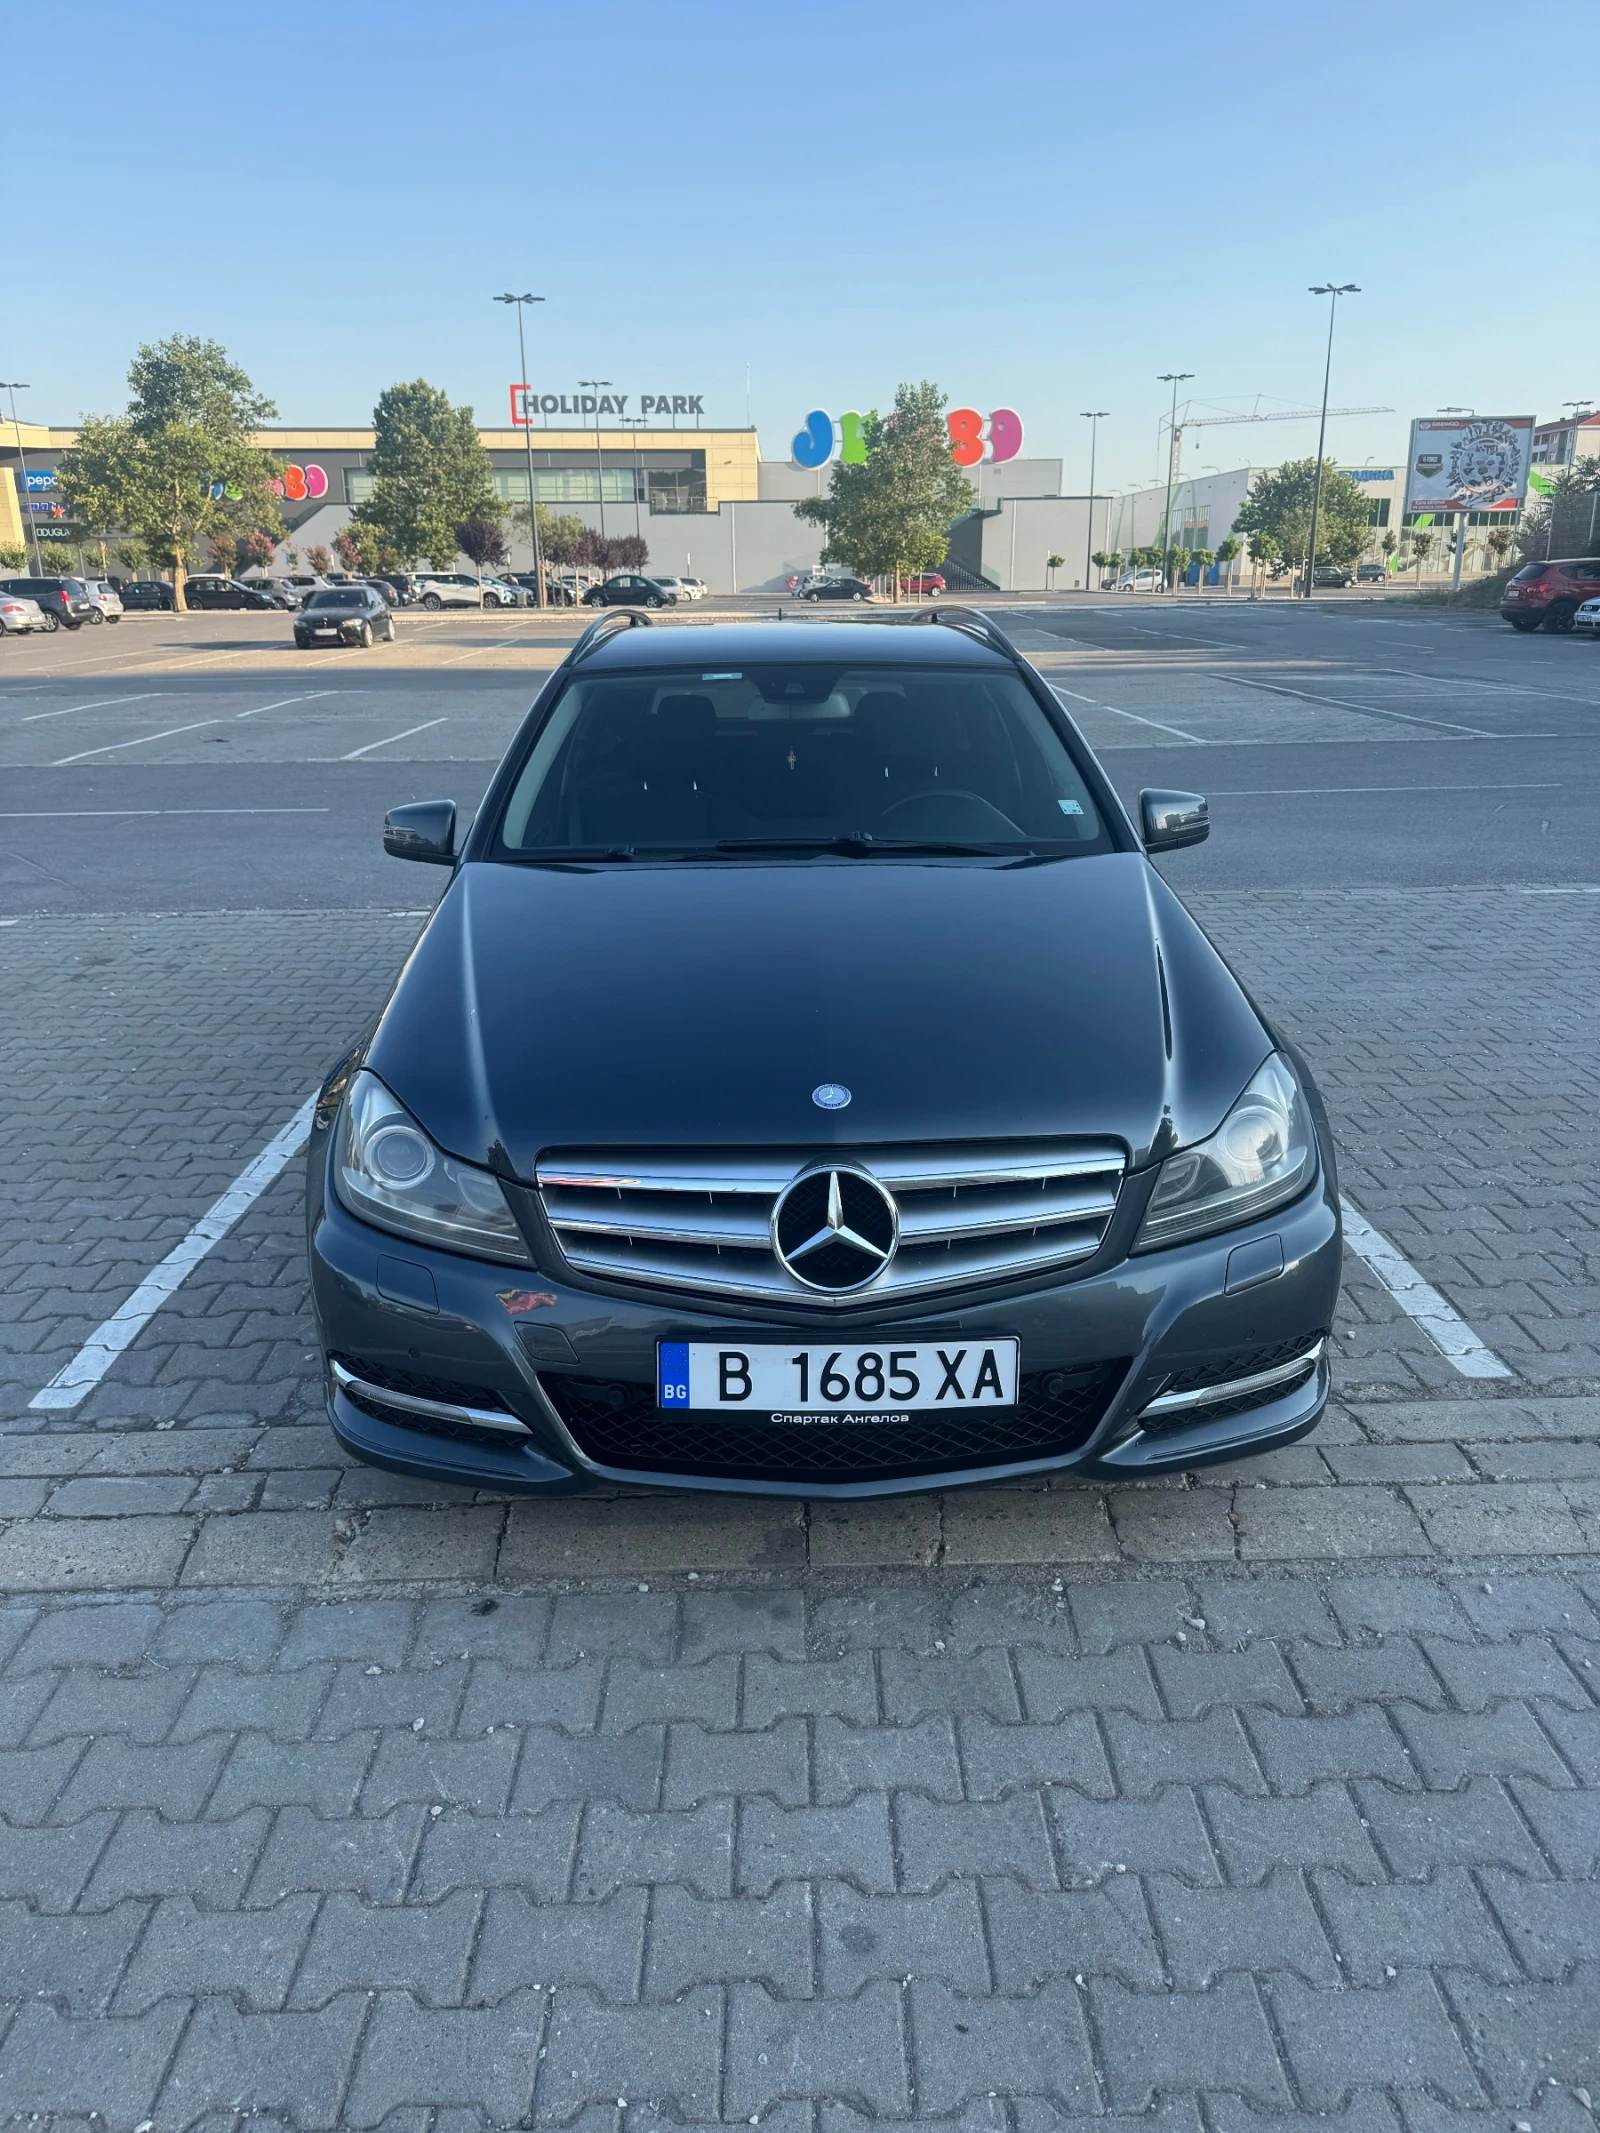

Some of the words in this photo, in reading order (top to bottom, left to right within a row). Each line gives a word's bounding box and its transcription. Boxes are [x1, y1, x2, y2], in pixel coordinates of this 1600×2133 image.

[523, 395, 629, 414] HOLIDAY
[641, 395, 705, 414] PARK
[792, 408, 1024, 471] JUBO
[27, 476, 58, 487] pepc
[719, 1351, 753, 1402] B
[792, 1351, 921, 1402] 1685
[936, 1349, 1004, 1400] XA
[664, 1385, 687, 1399] BG
[770, 1413, 838, 1425] Спартак
[842, 1414, 910, 1424] Ангелов
